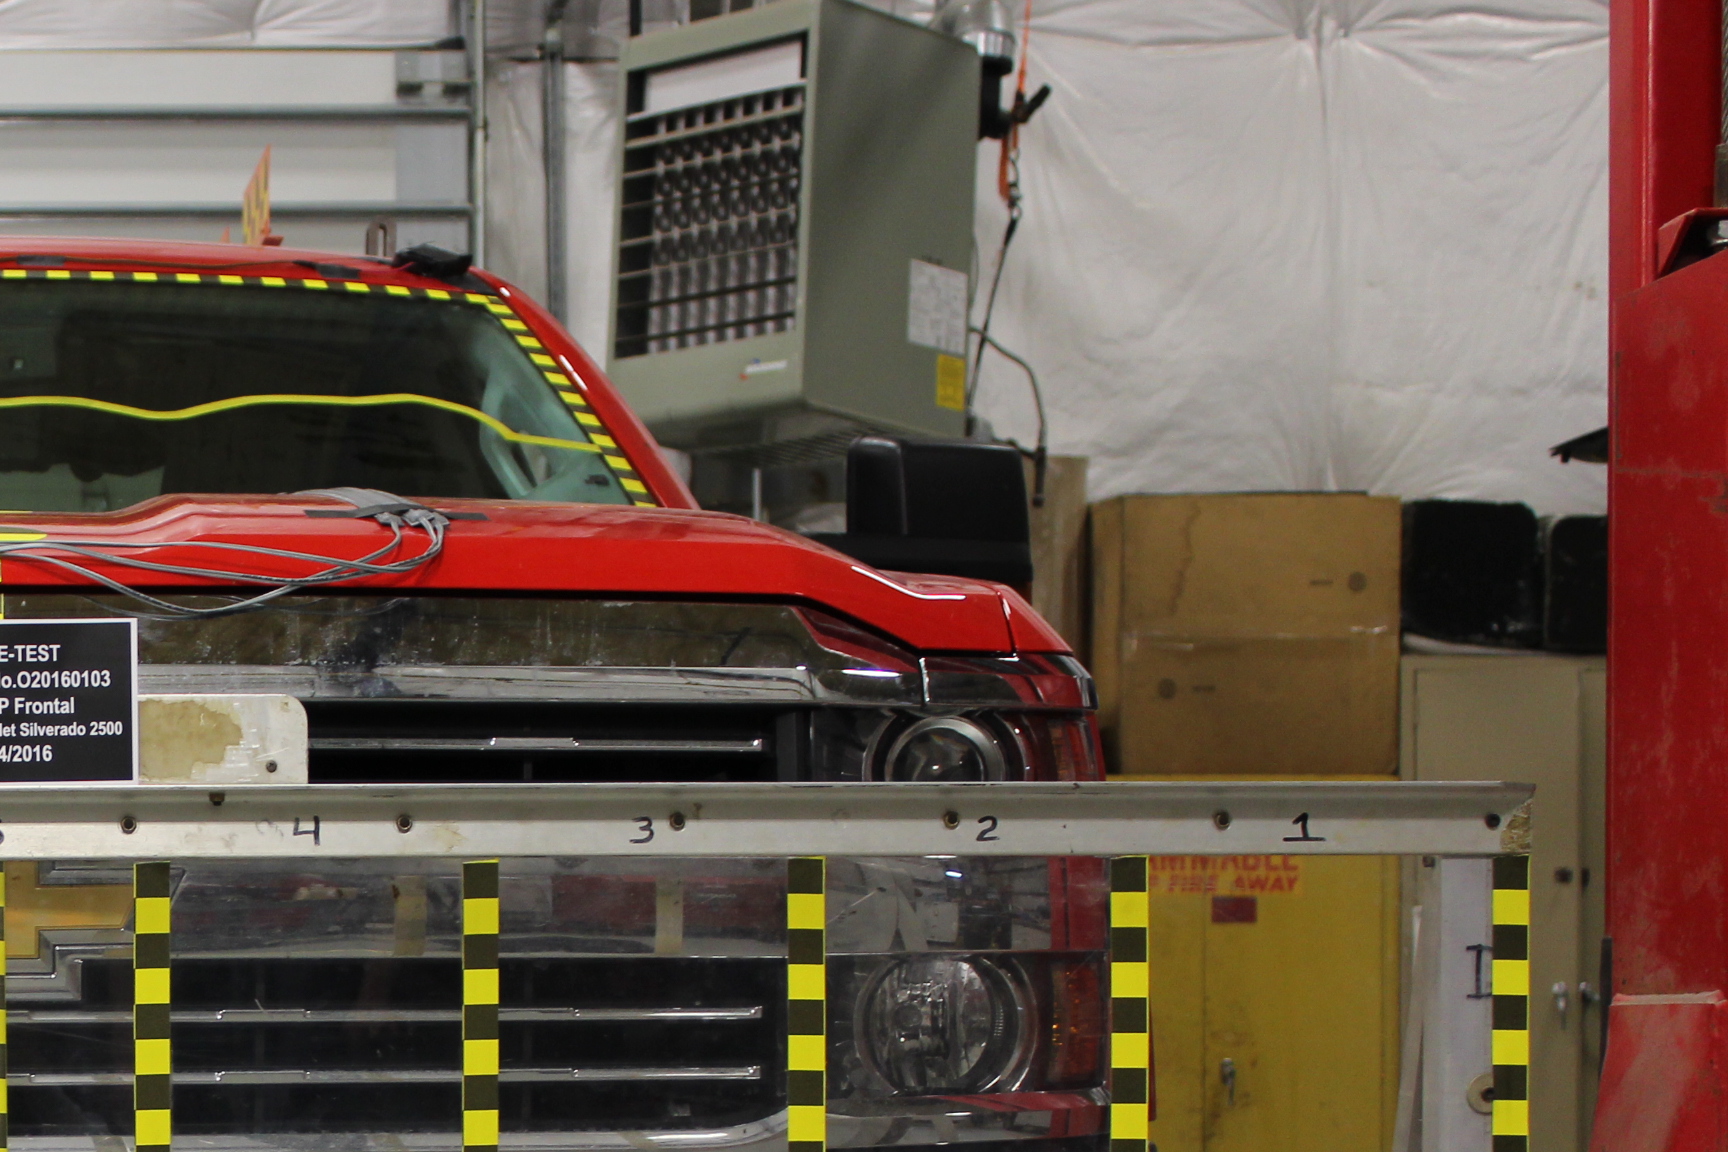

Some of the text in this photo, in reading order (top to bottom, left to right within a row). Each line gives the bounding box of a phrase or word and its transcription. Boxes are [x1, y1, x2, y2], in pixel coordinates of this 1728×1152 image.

[14, 696, 75, 715] Frontal
[19, 721, 87, 738] Silverado
[89, 720, 123, 736] 2500
[292, 815, 321, 847] 4
[629, 815, 655, 844] 3
[975, 815, 1001, 842] 2
[1282, 811, 1327, 842] 1
[1234, 874, 1299, 892] AWAY
